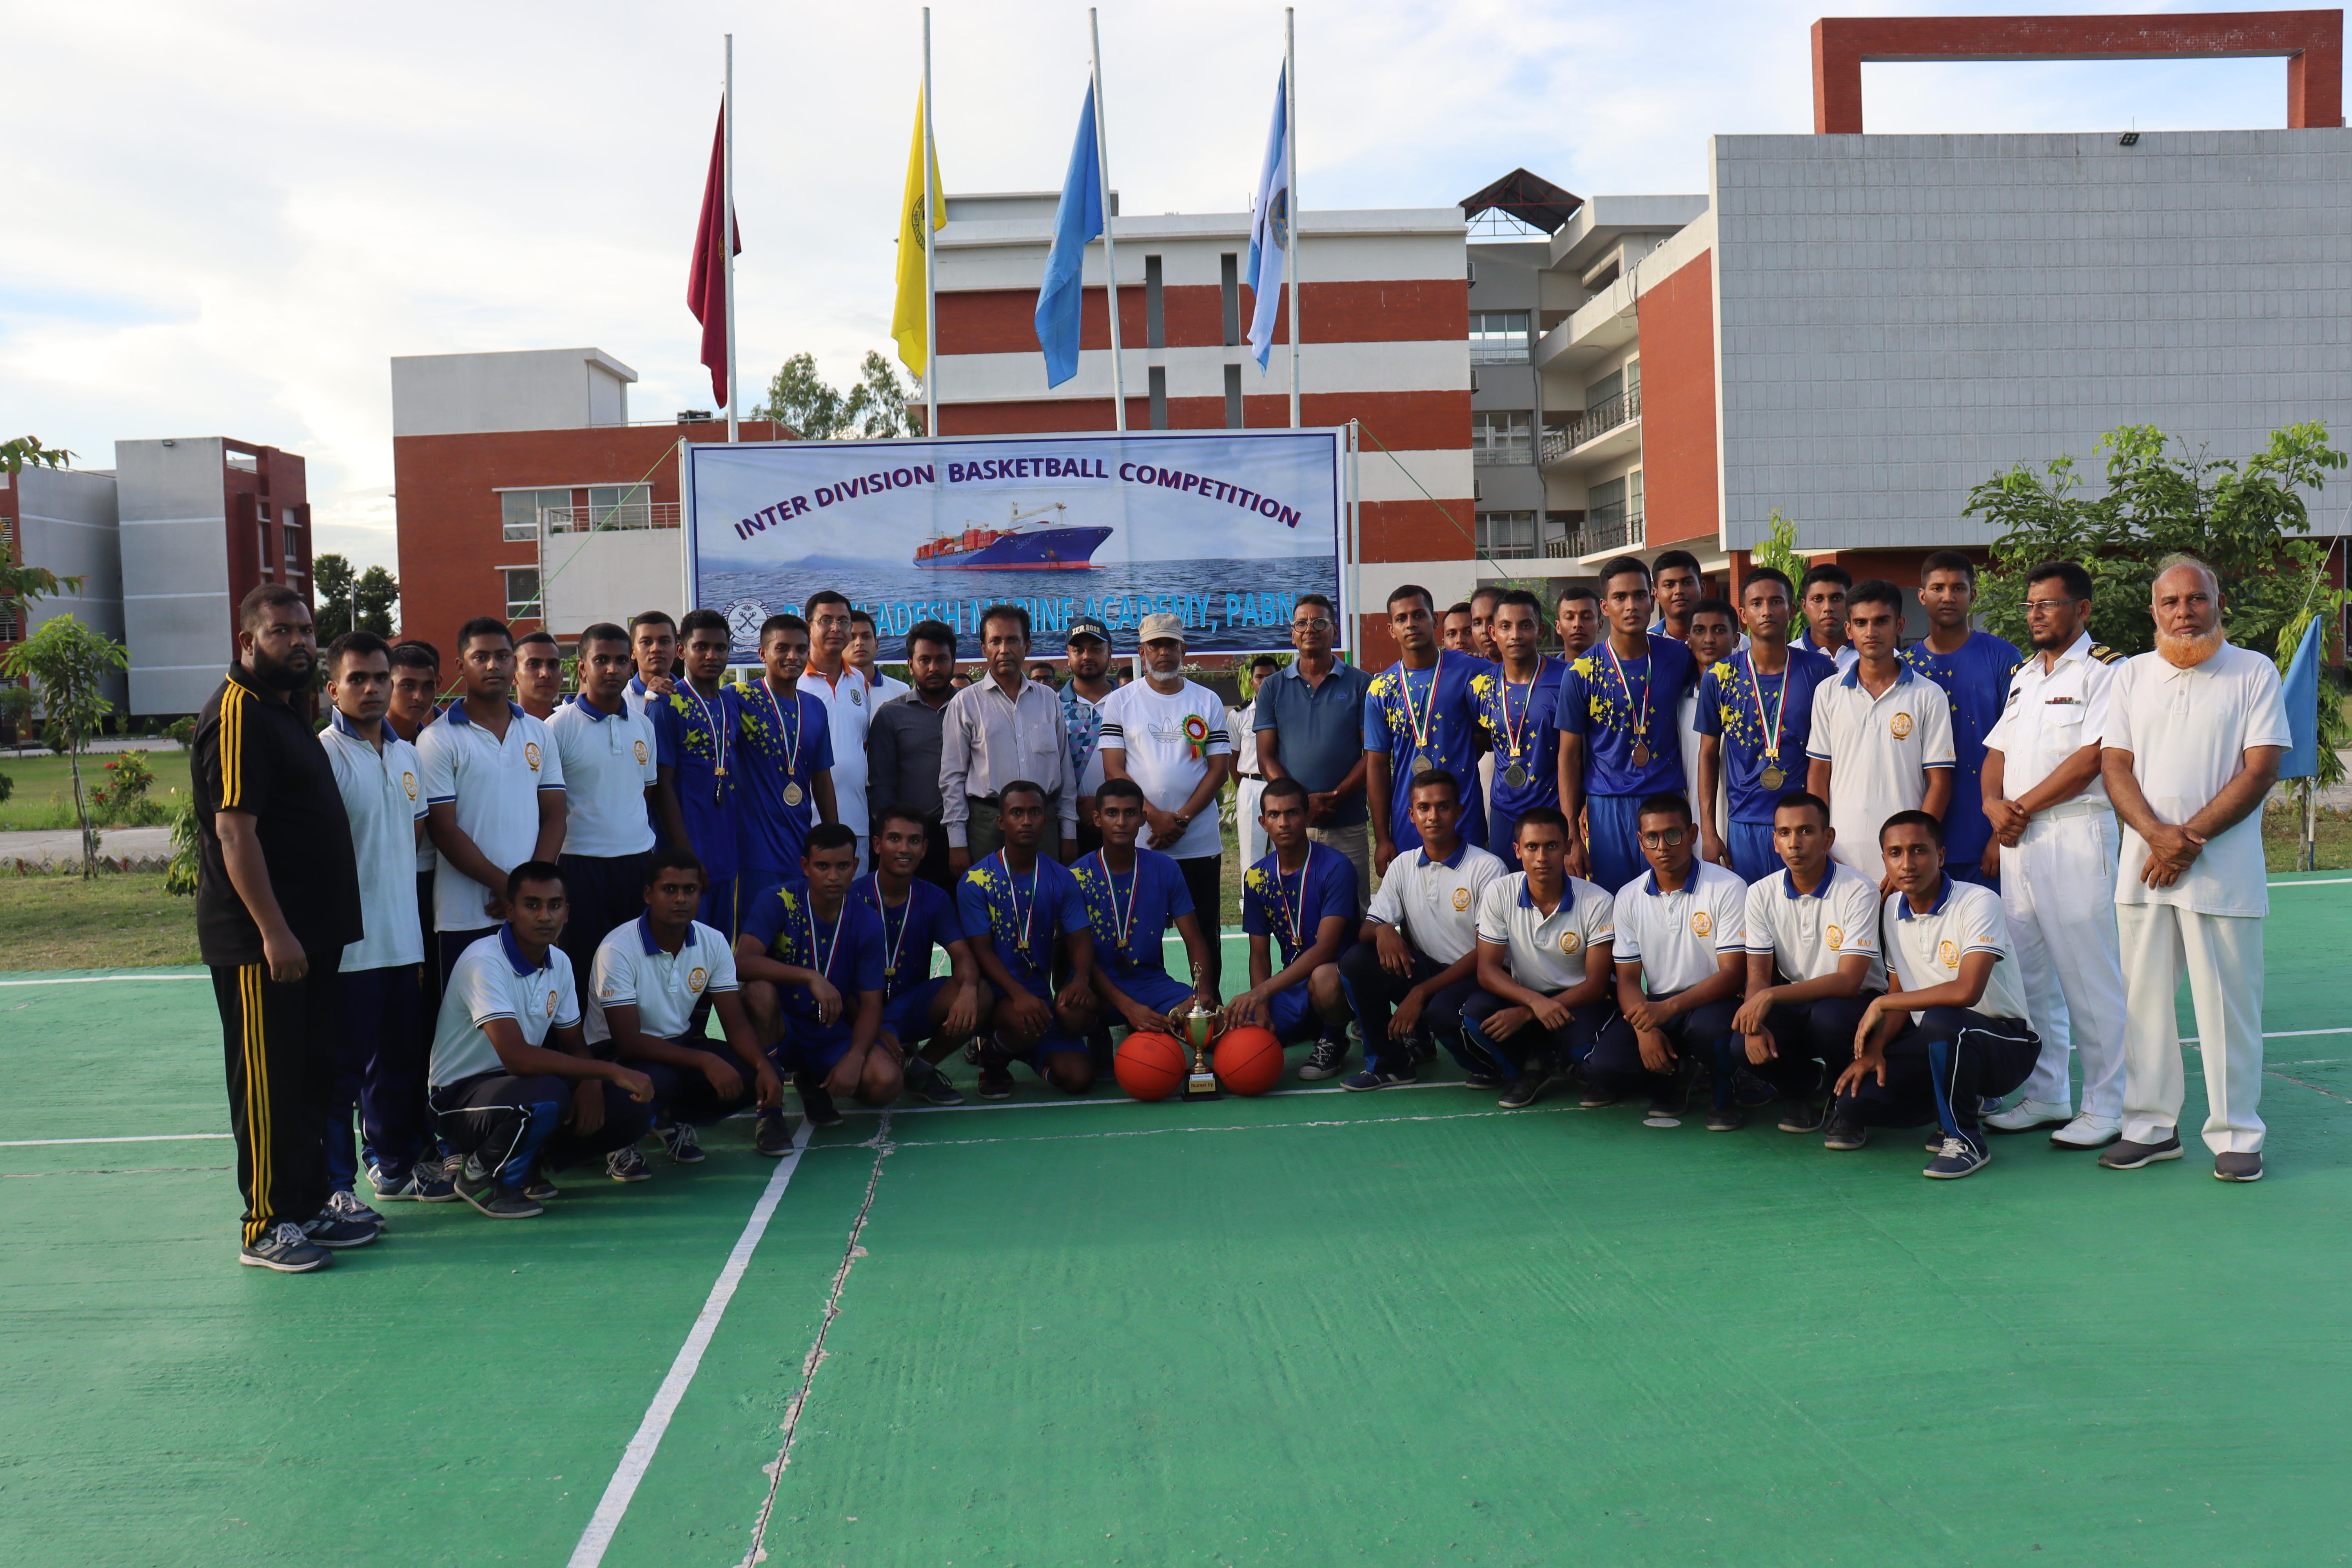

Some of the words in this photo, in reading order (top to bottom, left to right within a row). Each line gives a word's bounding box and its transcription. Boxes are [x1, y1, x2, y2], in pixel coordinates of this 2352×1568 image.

[734, 495, 812, 541] INTER
[814, 464, 935, 507] DIVISION
[948, 457, 1109, 483] BASKETBALL
[1118, 462, 1302, 529] COMPETITION
[1226, 591, 1310, 627] PABN
[1085, 624, 1101, 633] 2022
